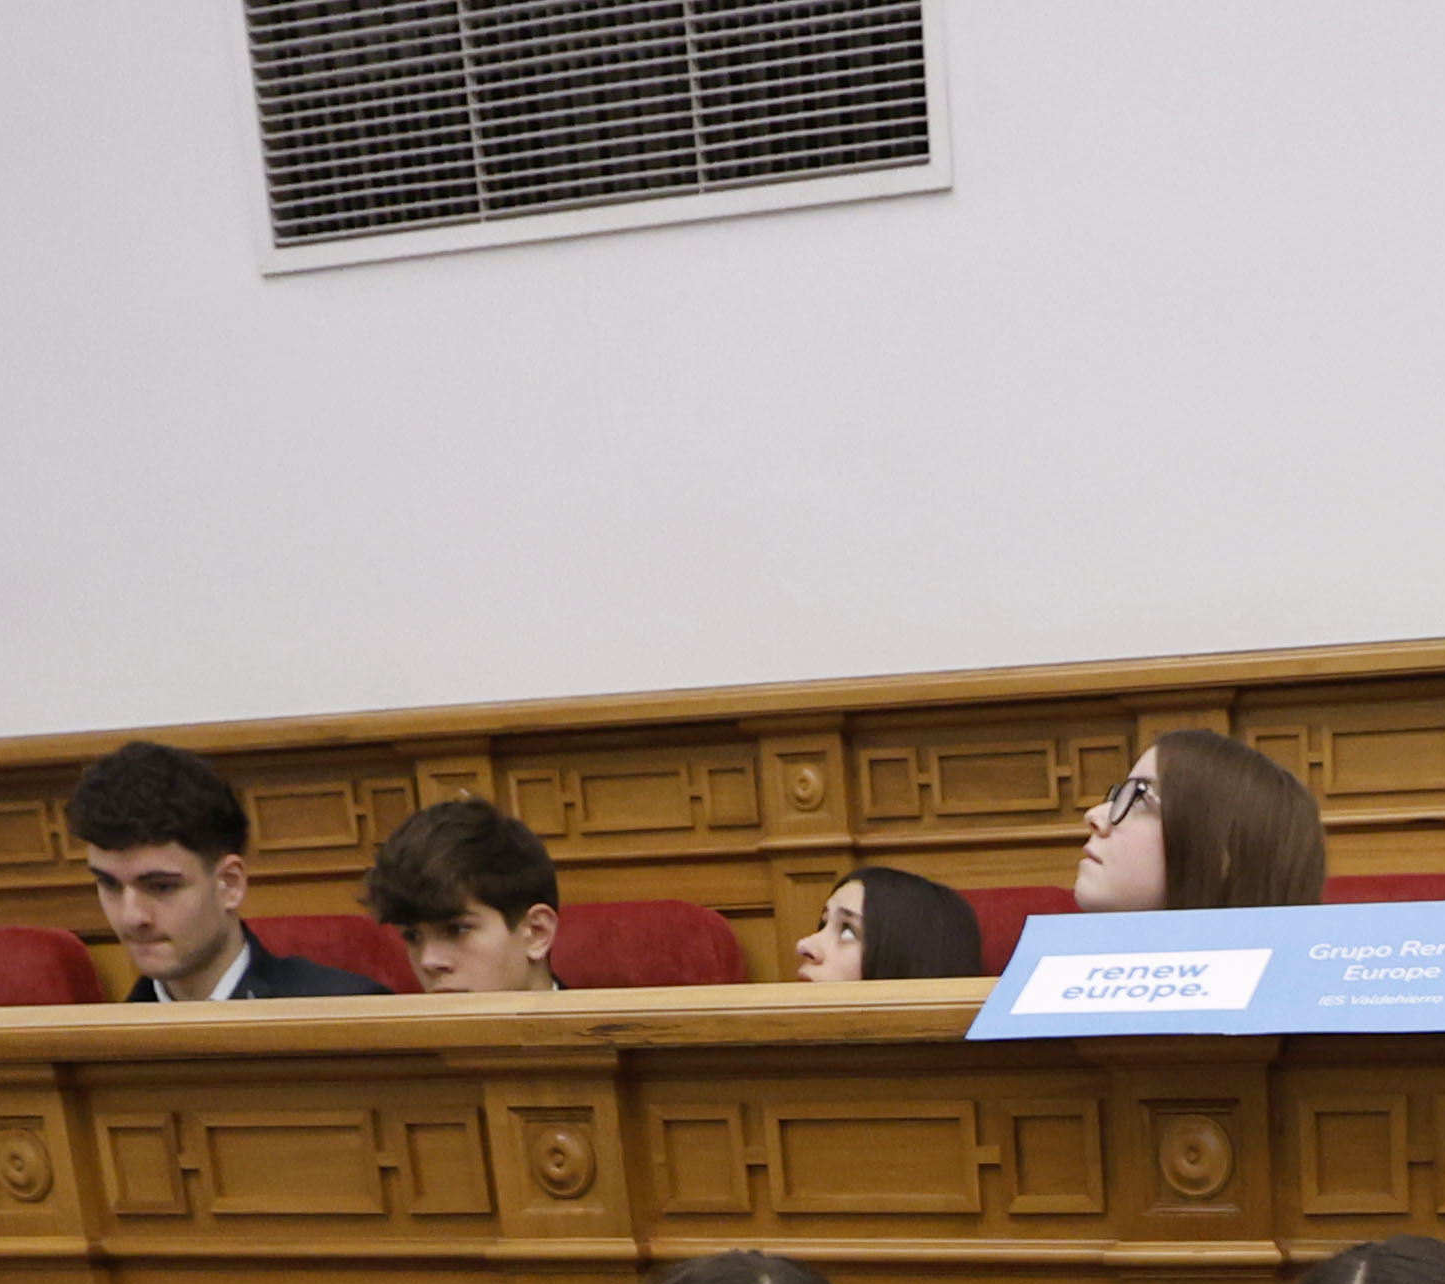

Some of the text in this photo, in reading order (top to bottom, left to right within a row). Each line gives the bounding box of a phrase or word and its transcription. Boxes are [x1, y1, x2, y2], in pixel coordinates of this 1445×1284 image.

[1308, 943, 1392, 961] Grupo
[1086, 963, 1210, 981] renew
[1342, 965, 1443, 982] Europe
[1061, 983, 1210, 1003] europe.
[1317, 995, 1345, 1007] IES
